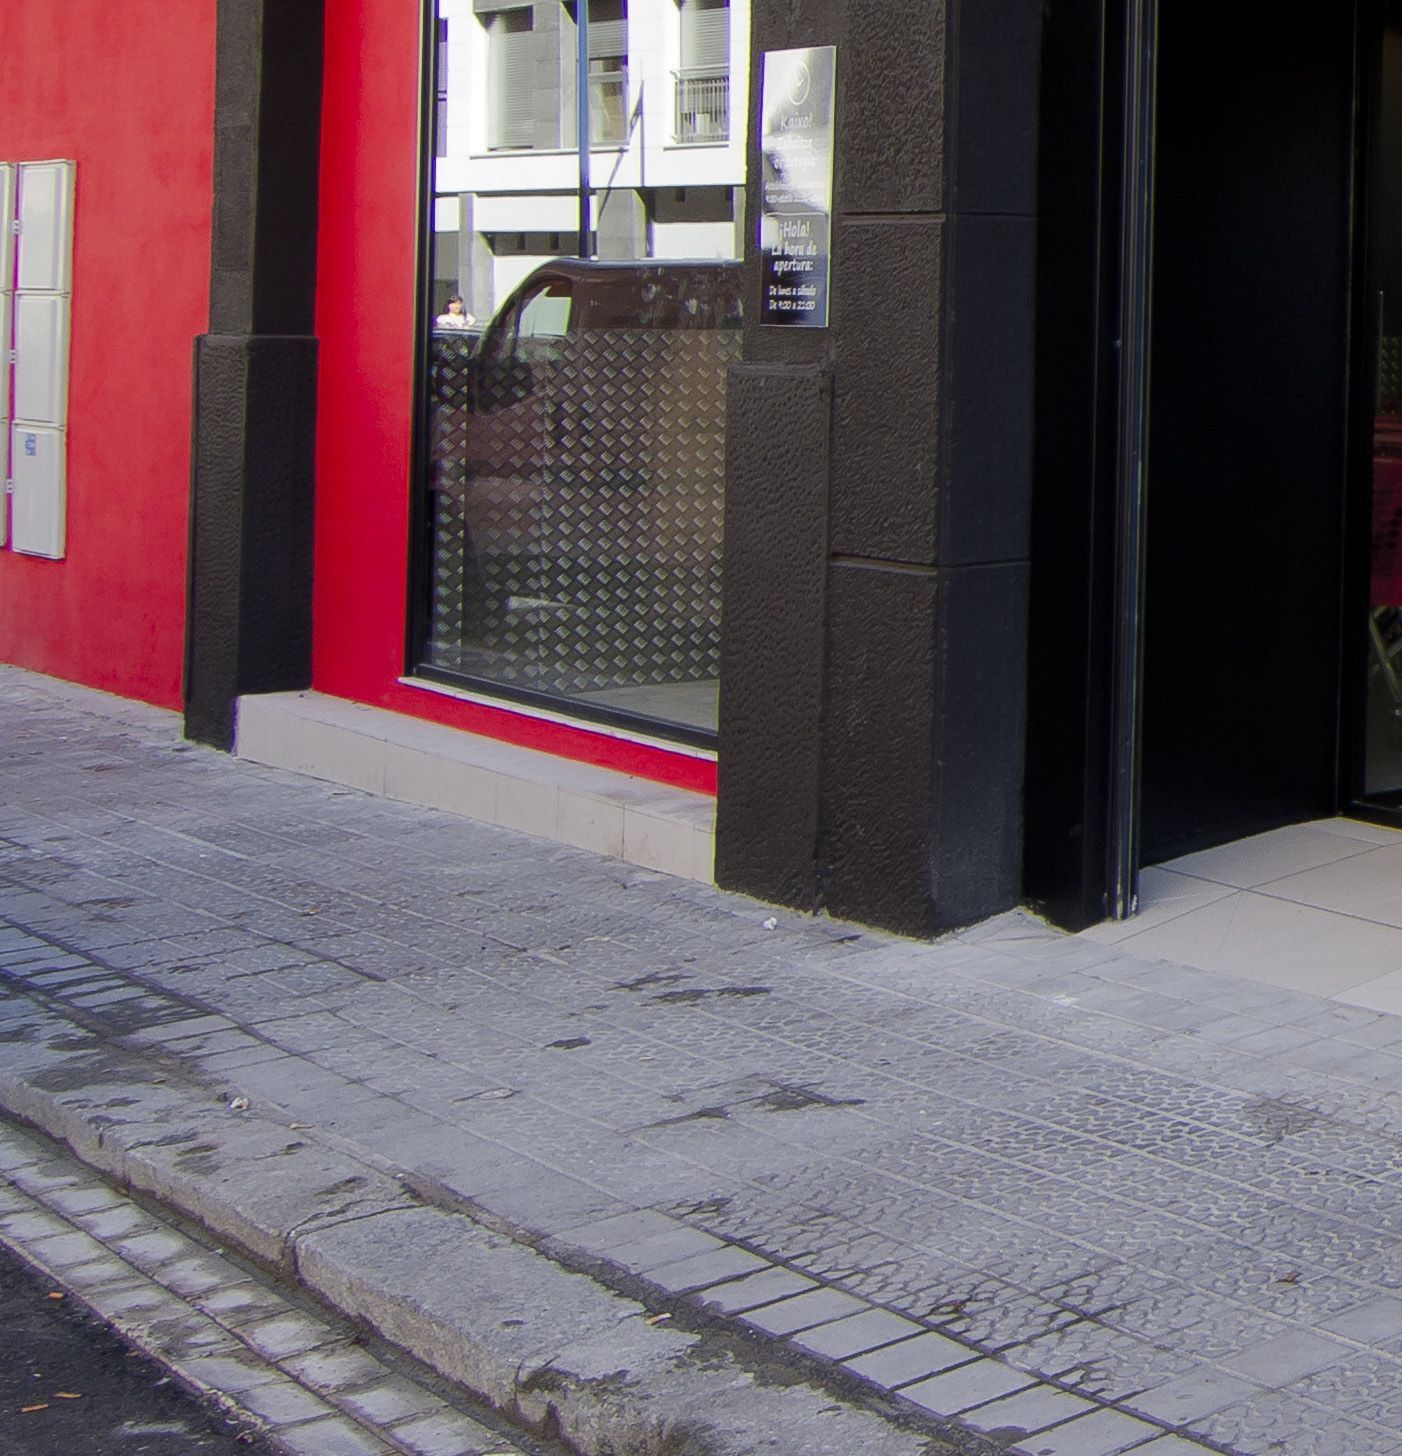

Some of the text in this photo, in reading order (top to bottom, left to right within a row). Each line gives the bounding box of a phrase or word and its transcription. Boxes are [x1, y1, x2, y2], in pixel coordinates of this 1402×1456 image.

[780, 111, 813, 131] Kaixo!
[779, 219, 810, 241] ¡Hola!
[771, 240, 817, 256] La hora de
[774, 258, 814, 276] apertura:
[769, 285, 777, 296] De
[769, 299, 777, 310] De
